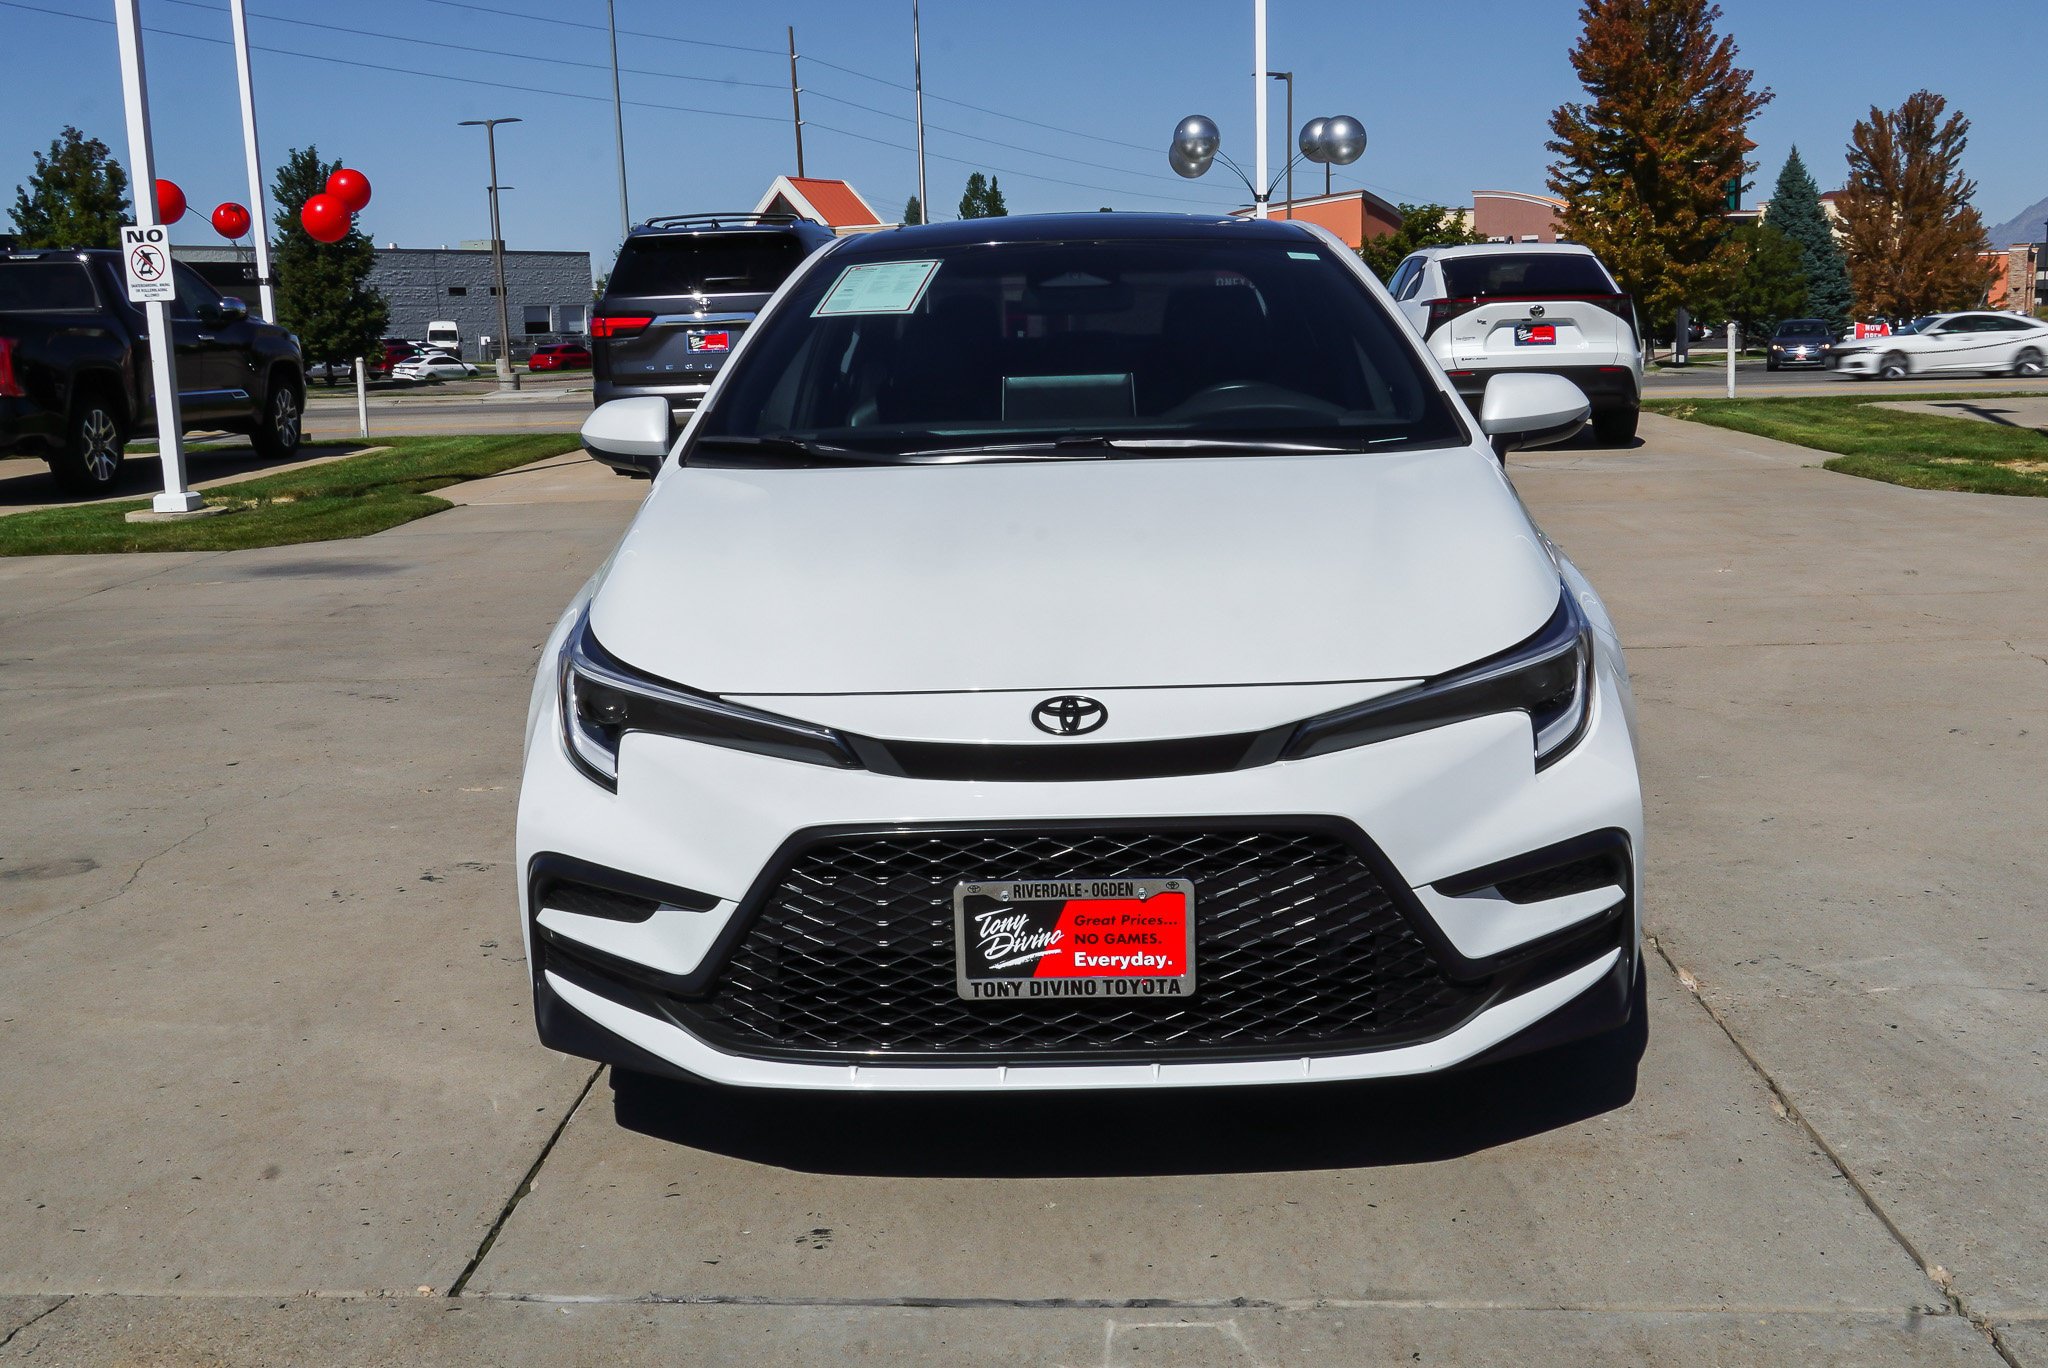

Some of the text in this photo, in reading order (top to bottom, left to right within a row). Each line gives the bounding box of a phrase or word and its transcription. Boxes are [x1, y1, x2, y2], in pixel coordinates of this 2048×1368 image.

[126, 229, 163, 243] NO
[1013, 883, 1082, 898] RIVERDALE
[1092, 882, 1134, 897] OGDEN
[975, 907, 1030, 938] Tony
[1074, 914, 1177, 926] Great Prices...
[976, 927, 1065, 960] Divino
[1074, 933, 1162, 944] NO GAMES.
[1074, 951, 1173, 970] Everyday.
[971, 979, 1181, 998] TONY DIVINO TOYOTA
